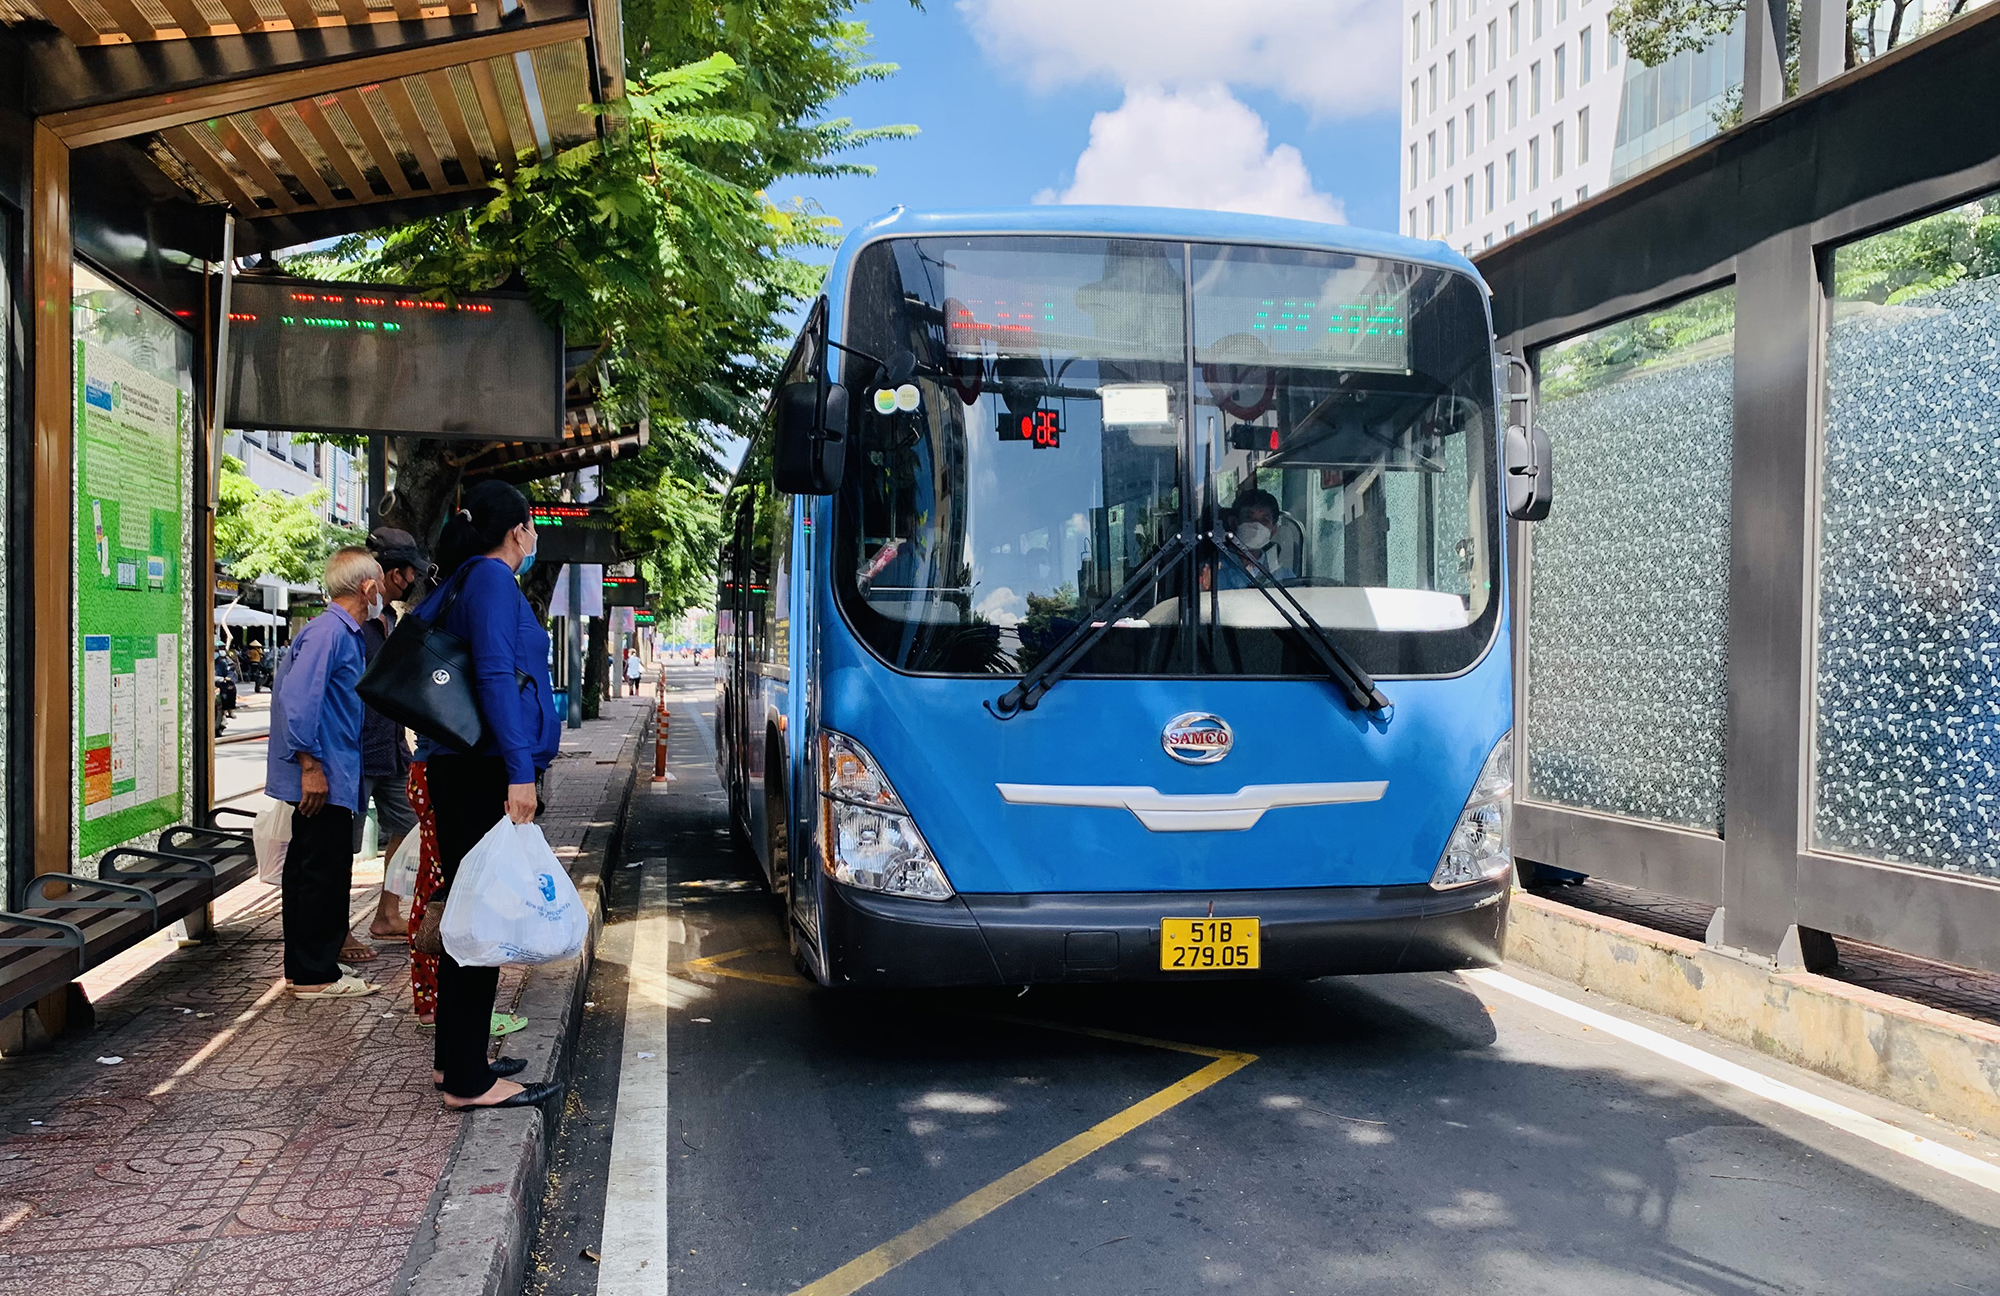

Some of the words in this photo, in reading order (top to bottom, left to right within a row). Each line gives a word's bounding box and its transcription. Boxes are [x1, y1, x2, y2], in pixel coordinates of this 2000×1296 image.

[1169, 731, 1229, 745] SAMCO
[1191, 922, 1232, 943] 51B
[1172, 945, 1249, 967] 279.05
